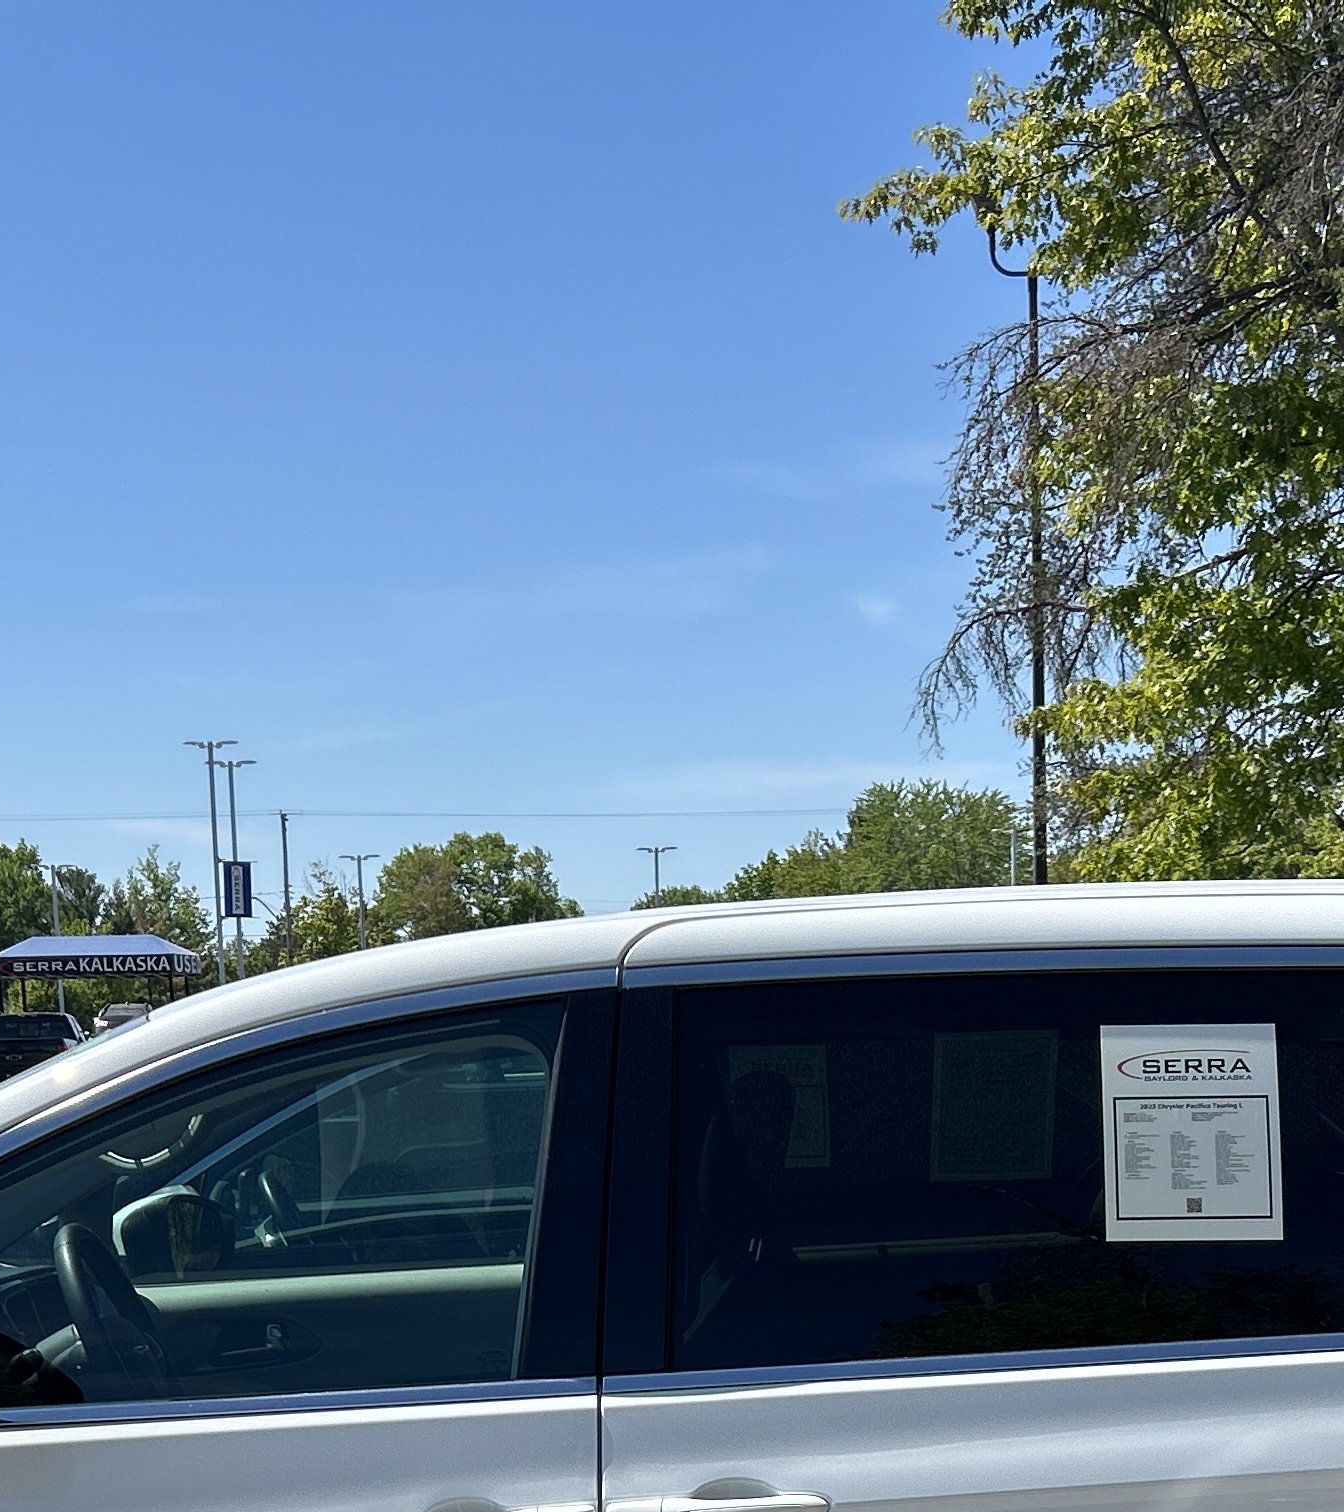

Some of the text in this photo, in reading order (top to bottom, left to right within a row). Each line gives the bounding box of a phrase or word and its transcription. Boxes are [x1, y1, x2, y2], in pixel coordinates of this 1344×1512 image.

[12, 960, 78, 972] SERRA
[78, 955, 171, 973] KALKASKA
[1142, 1058, 1251, 1074] SERRA
[1157, 1103, 1184, 1111] Chrysler
